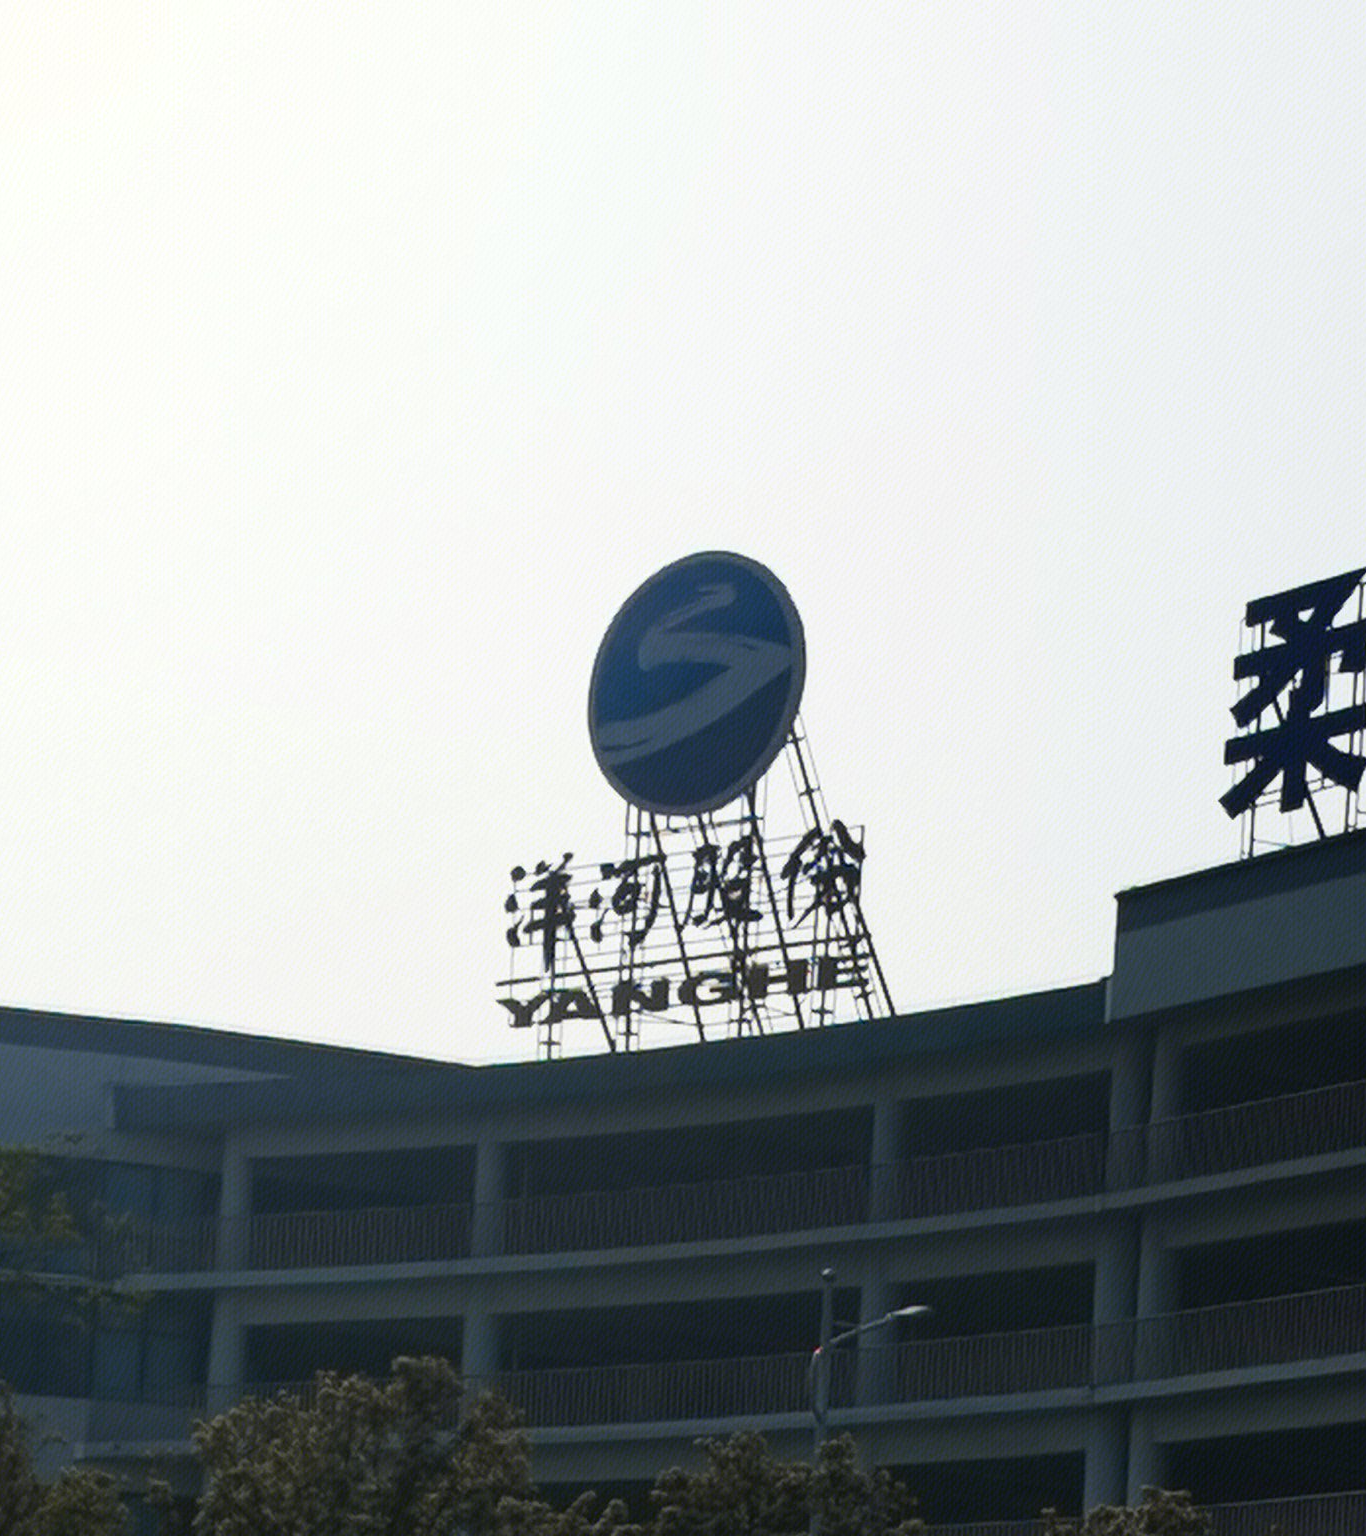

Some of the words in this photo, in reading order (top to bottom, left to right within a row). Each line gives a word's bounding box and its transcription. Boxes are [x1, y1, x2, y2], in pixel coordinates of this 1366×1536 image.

[504, 819, 866, 972] 洋河股份
[496, 956, 869, 1028] YANGHE
